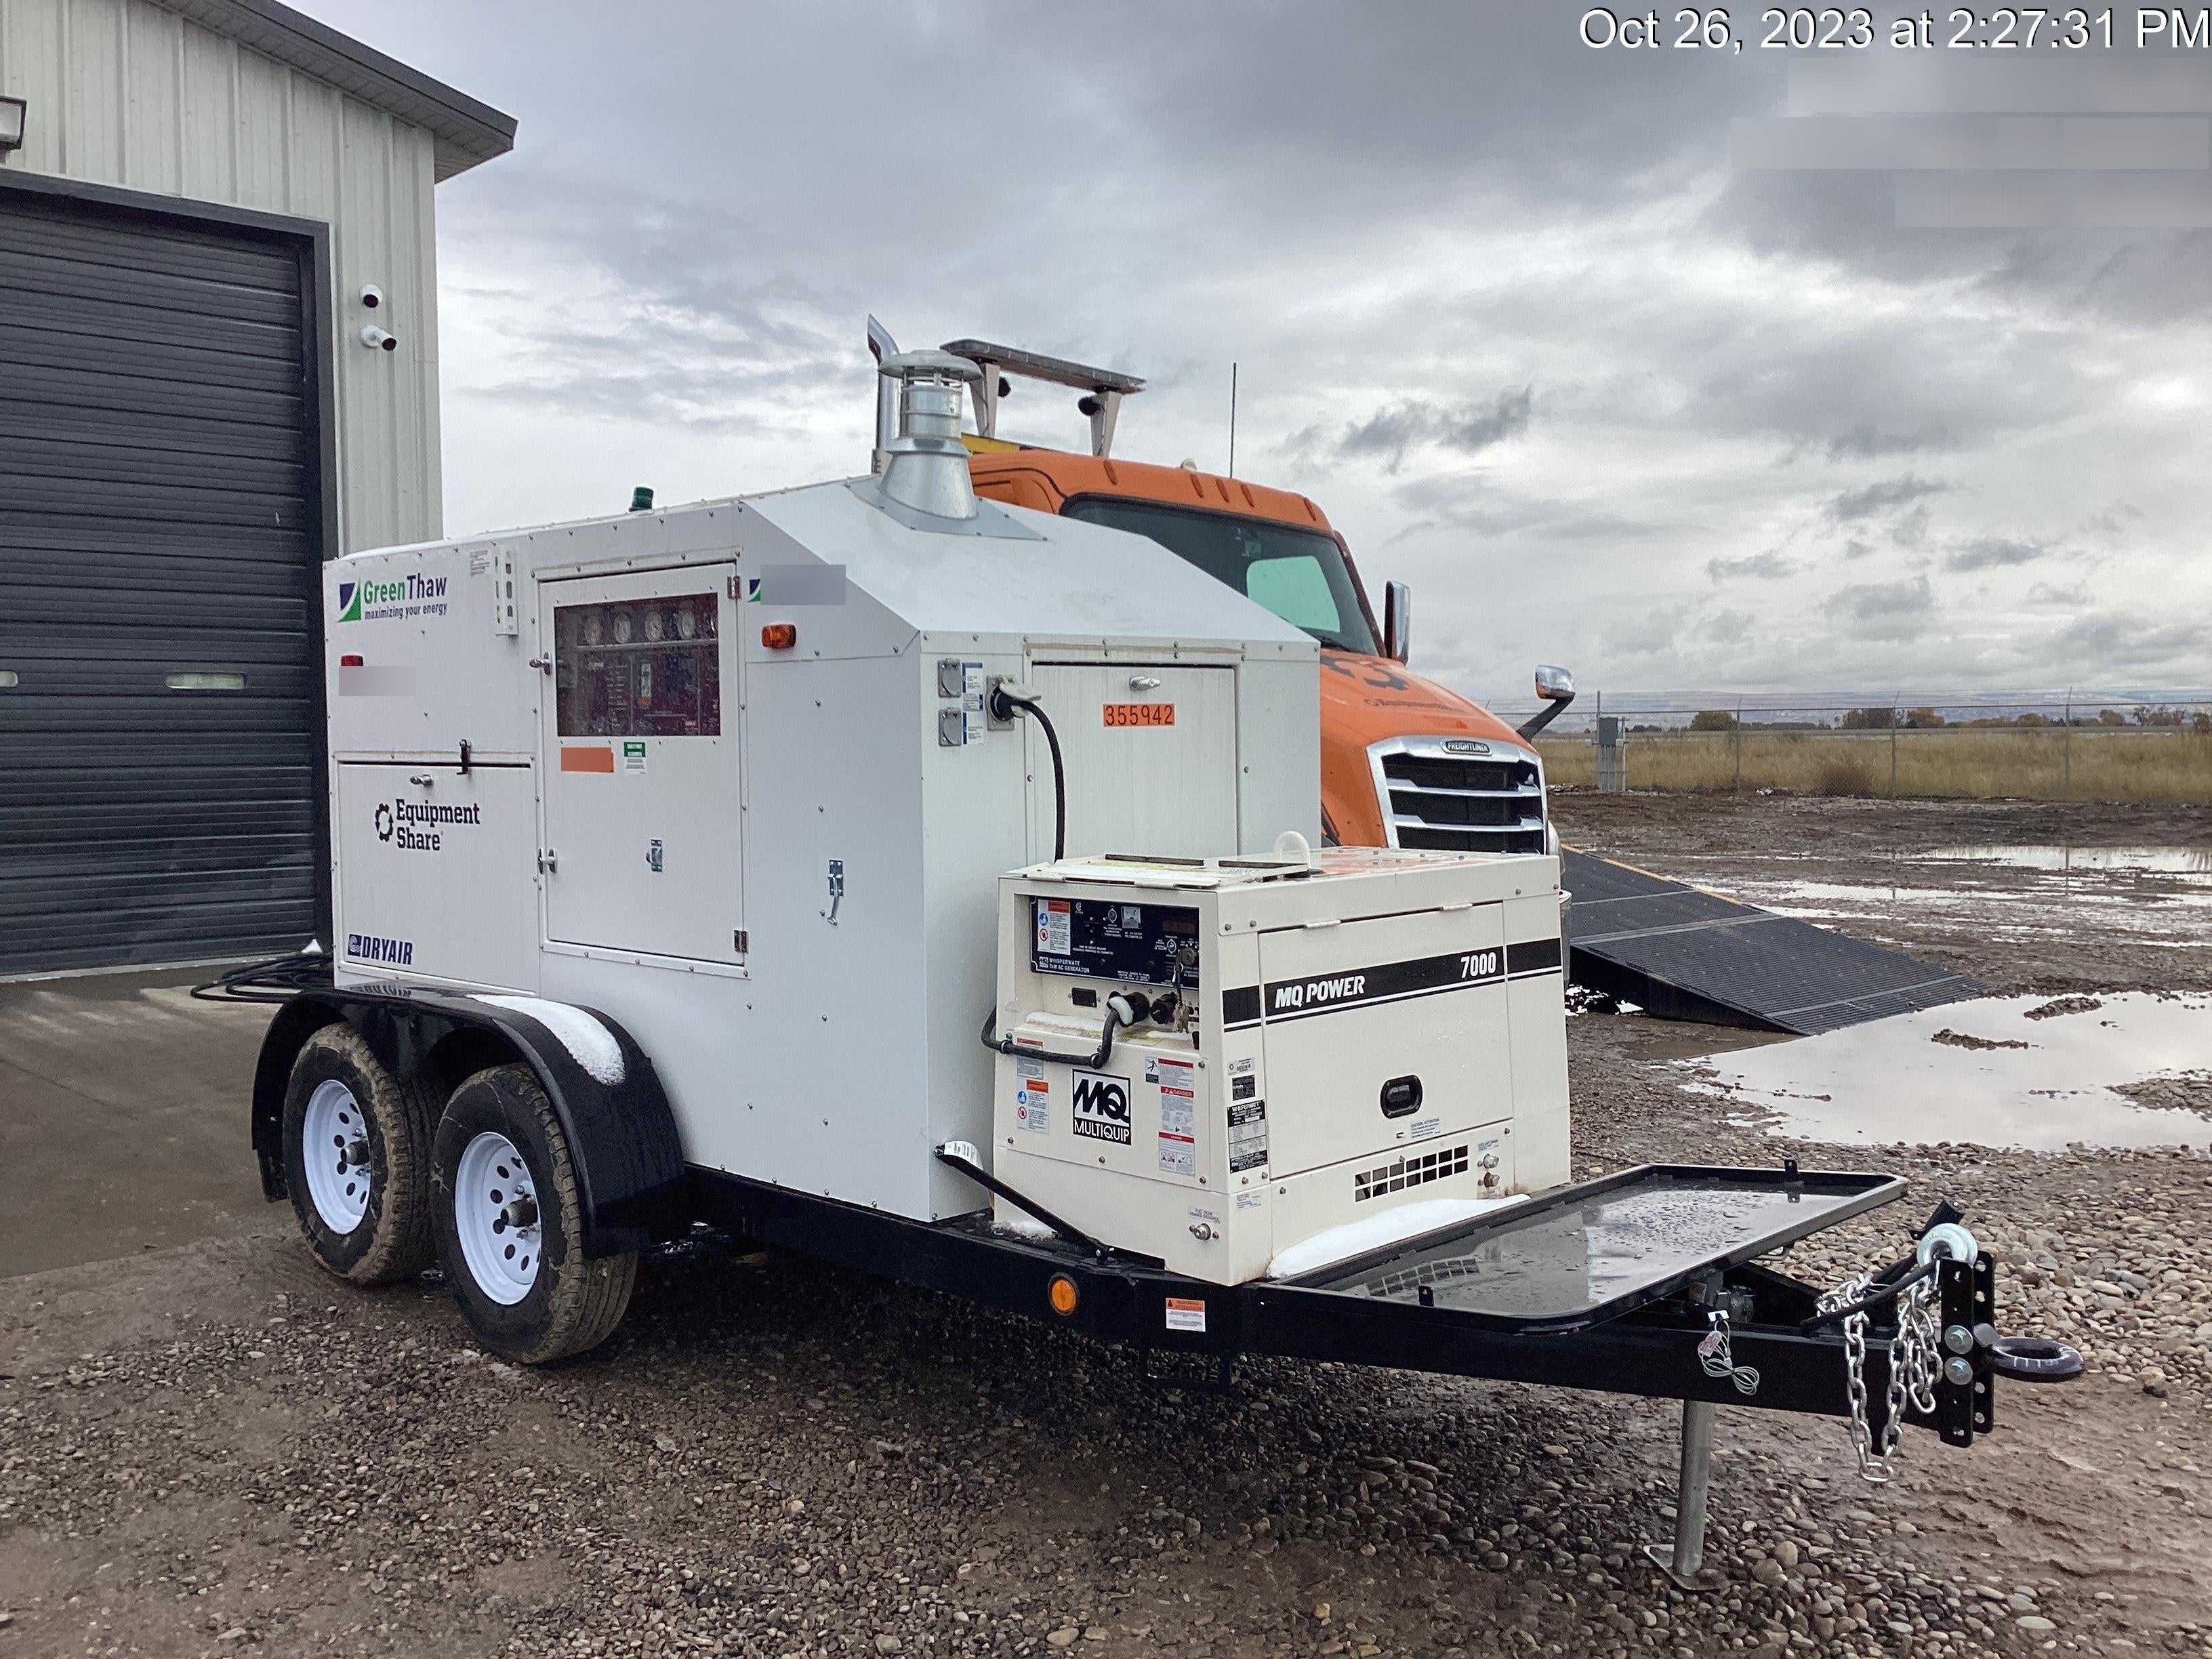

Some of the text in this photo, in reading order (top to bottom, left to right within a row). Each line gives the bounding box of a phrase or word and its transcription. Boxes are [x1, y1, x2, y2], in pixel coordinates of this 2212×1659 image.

[365, 602, 448, 621] maximizing your energy
[1105, 705, 1173, 726] 355942
[1448, 742, 1489, 752] FREIGHTLINER
[396, 798, 480, 827] Equipment
[396, 826, 441, 851] Share
[362, 936, 413, 965] DRYAIR
[1274, 951, 1497, 1010] MQ POWER 7000
[1073, 1078, 1130, 1124] MQ
[1074, 1119, 1130, 1143] MULTIQUIP
